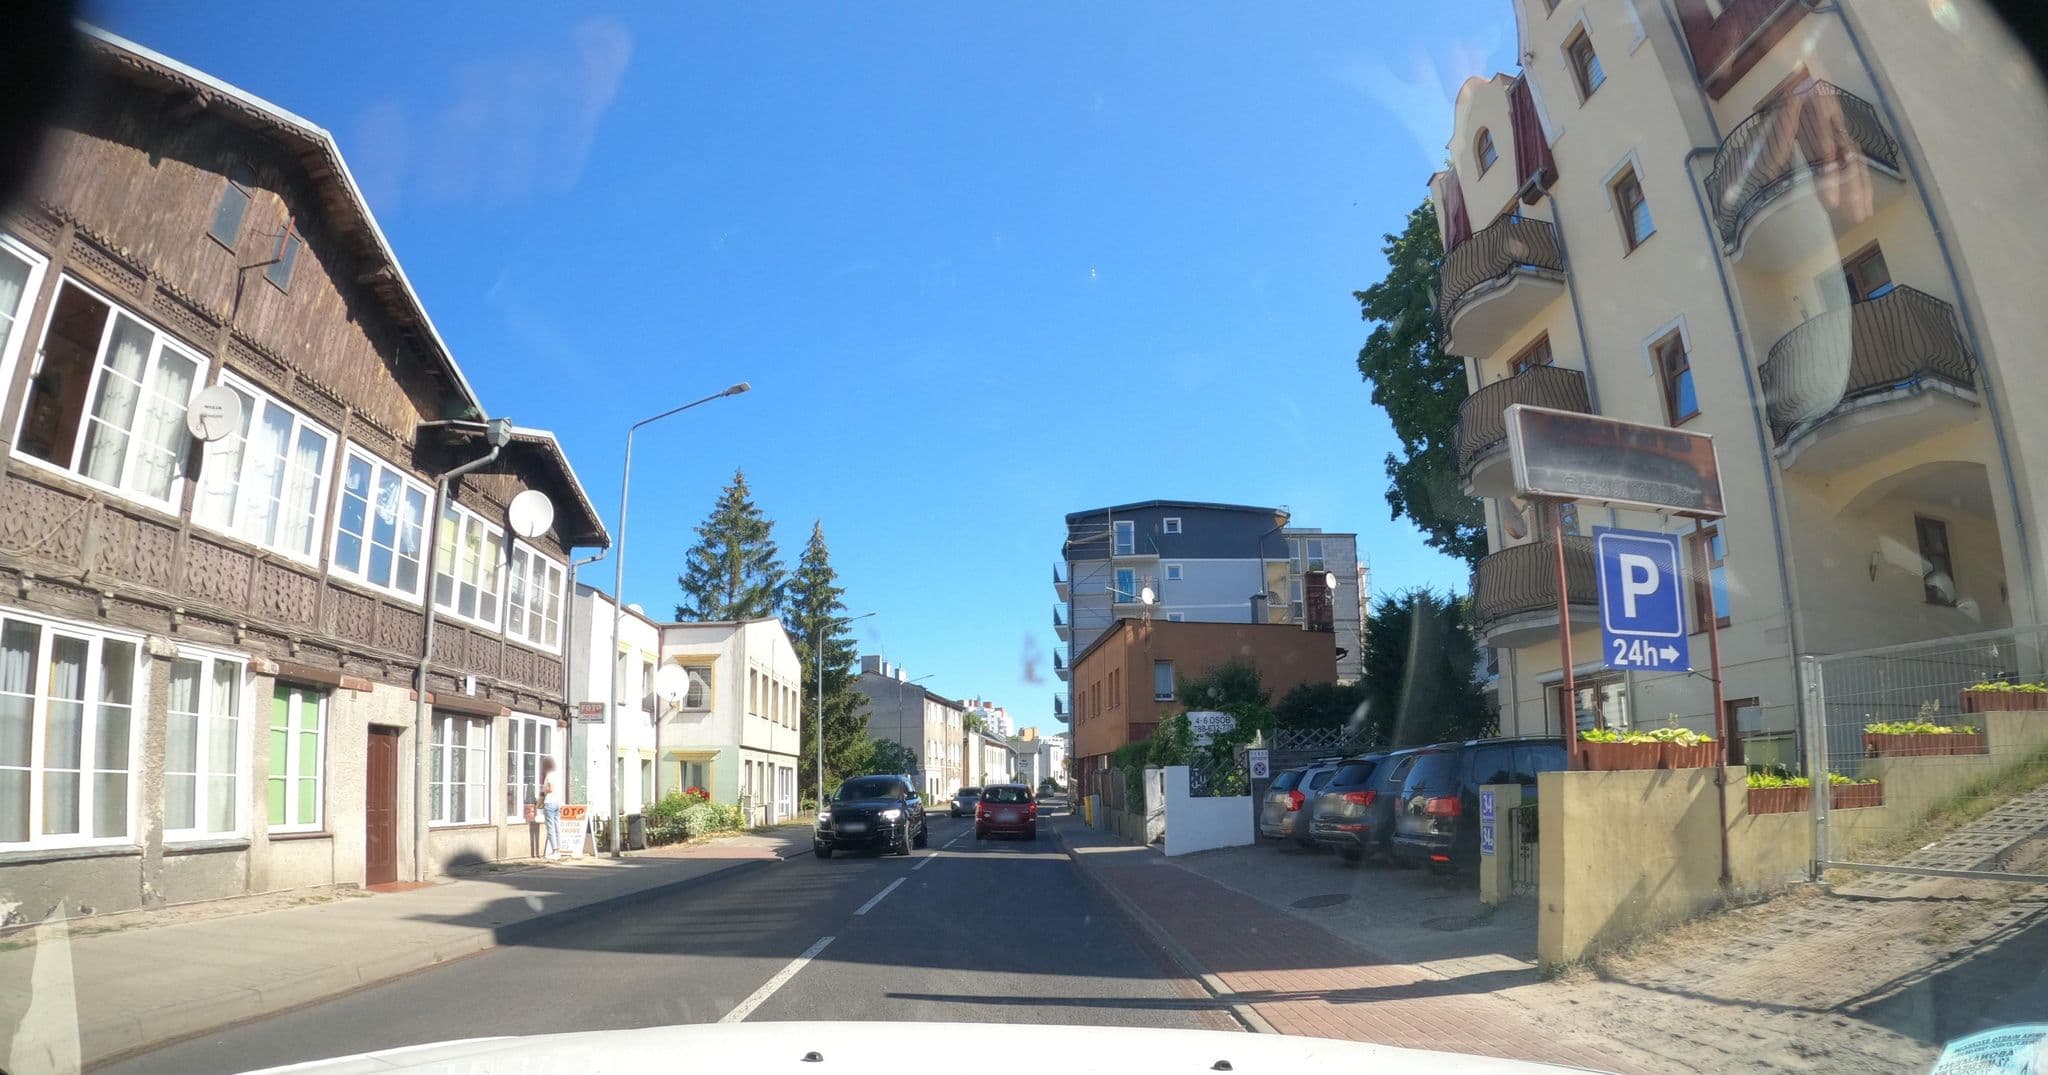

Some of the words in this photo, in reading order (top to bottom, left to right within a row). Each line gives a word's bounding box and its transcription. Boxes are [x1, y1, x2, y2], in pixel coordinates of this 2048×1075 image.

[1619, 553, 1660, 618] P
[1613, 639, 1659, 667] 24h
[581, 704, 602, 712] FOTO
[1483, 794, 1493, 814] 34
